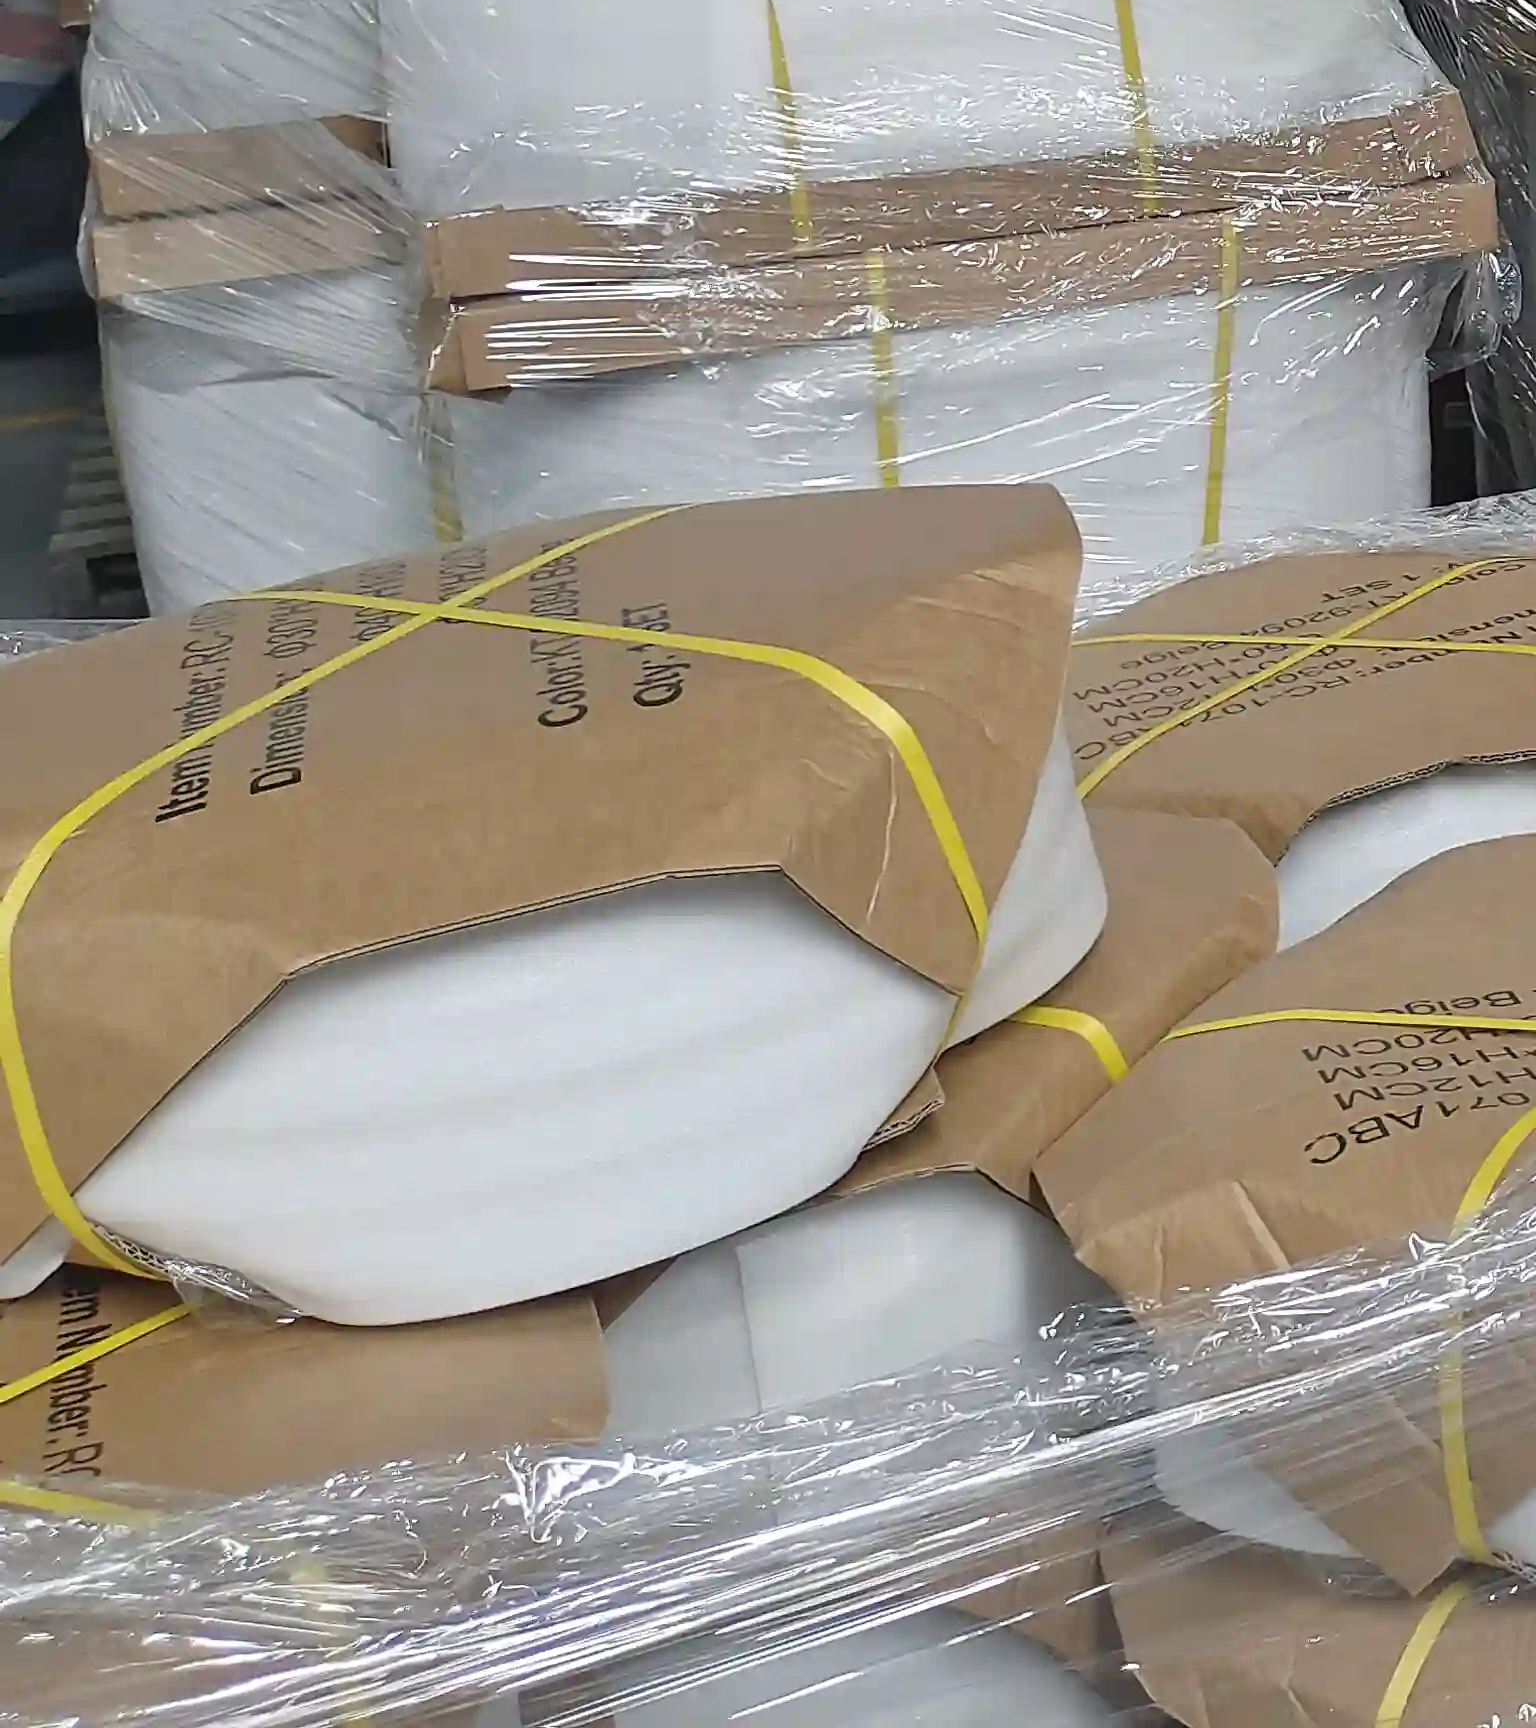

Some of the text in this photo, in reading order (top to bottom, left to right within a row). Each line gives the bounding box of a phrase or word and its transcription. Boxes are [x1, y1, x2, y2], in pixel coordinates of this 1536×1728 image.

[1319, 578, 1393, 604] SET
[633, 654, 692, 708] Qty:
[46, 1323, 113, 1446] Nmber:
